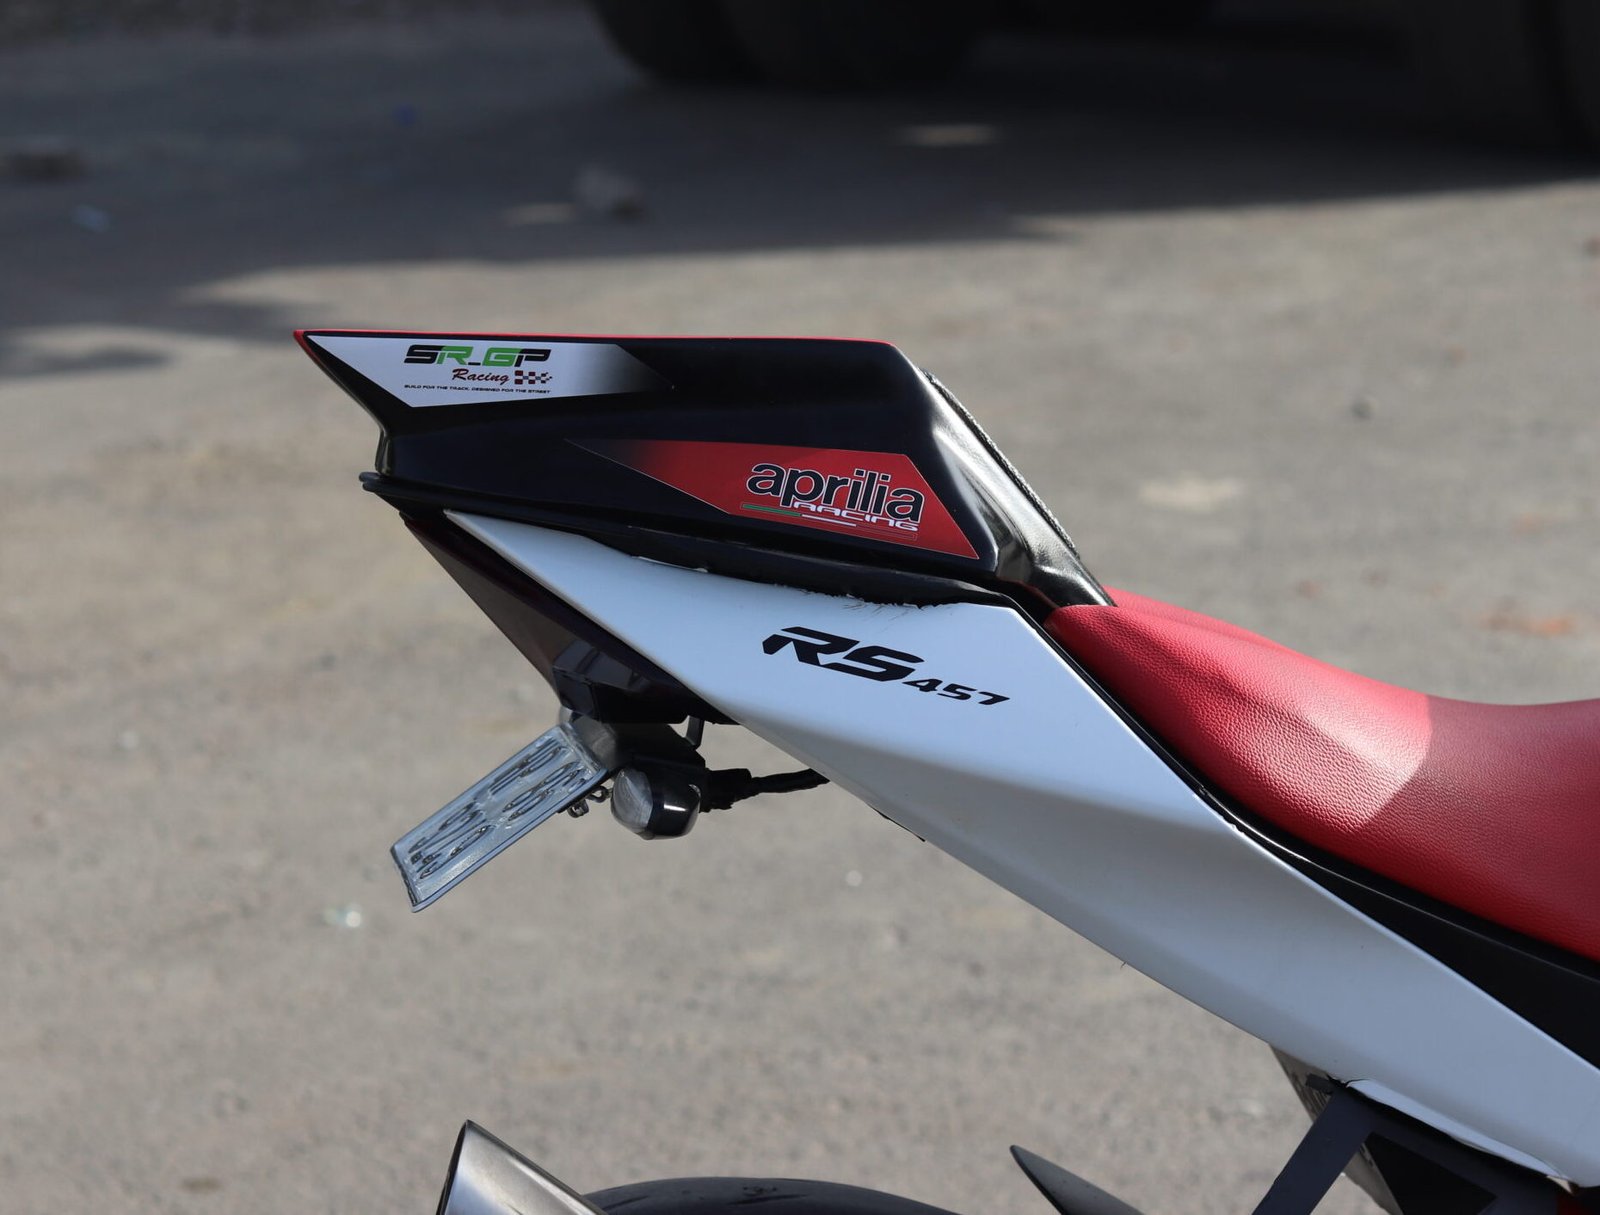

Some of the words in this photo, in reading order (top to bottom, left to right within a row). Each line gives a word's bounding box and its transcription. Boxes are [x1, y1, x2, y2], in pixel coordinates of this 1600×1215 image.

[451, 368, 511, 386] Racing
[745, 462, 925, 524] aprilia
[792, 501, 920, 532] RACING
[762, 626, 925, 682] RS
[901, 678, 1011, 706] 457
